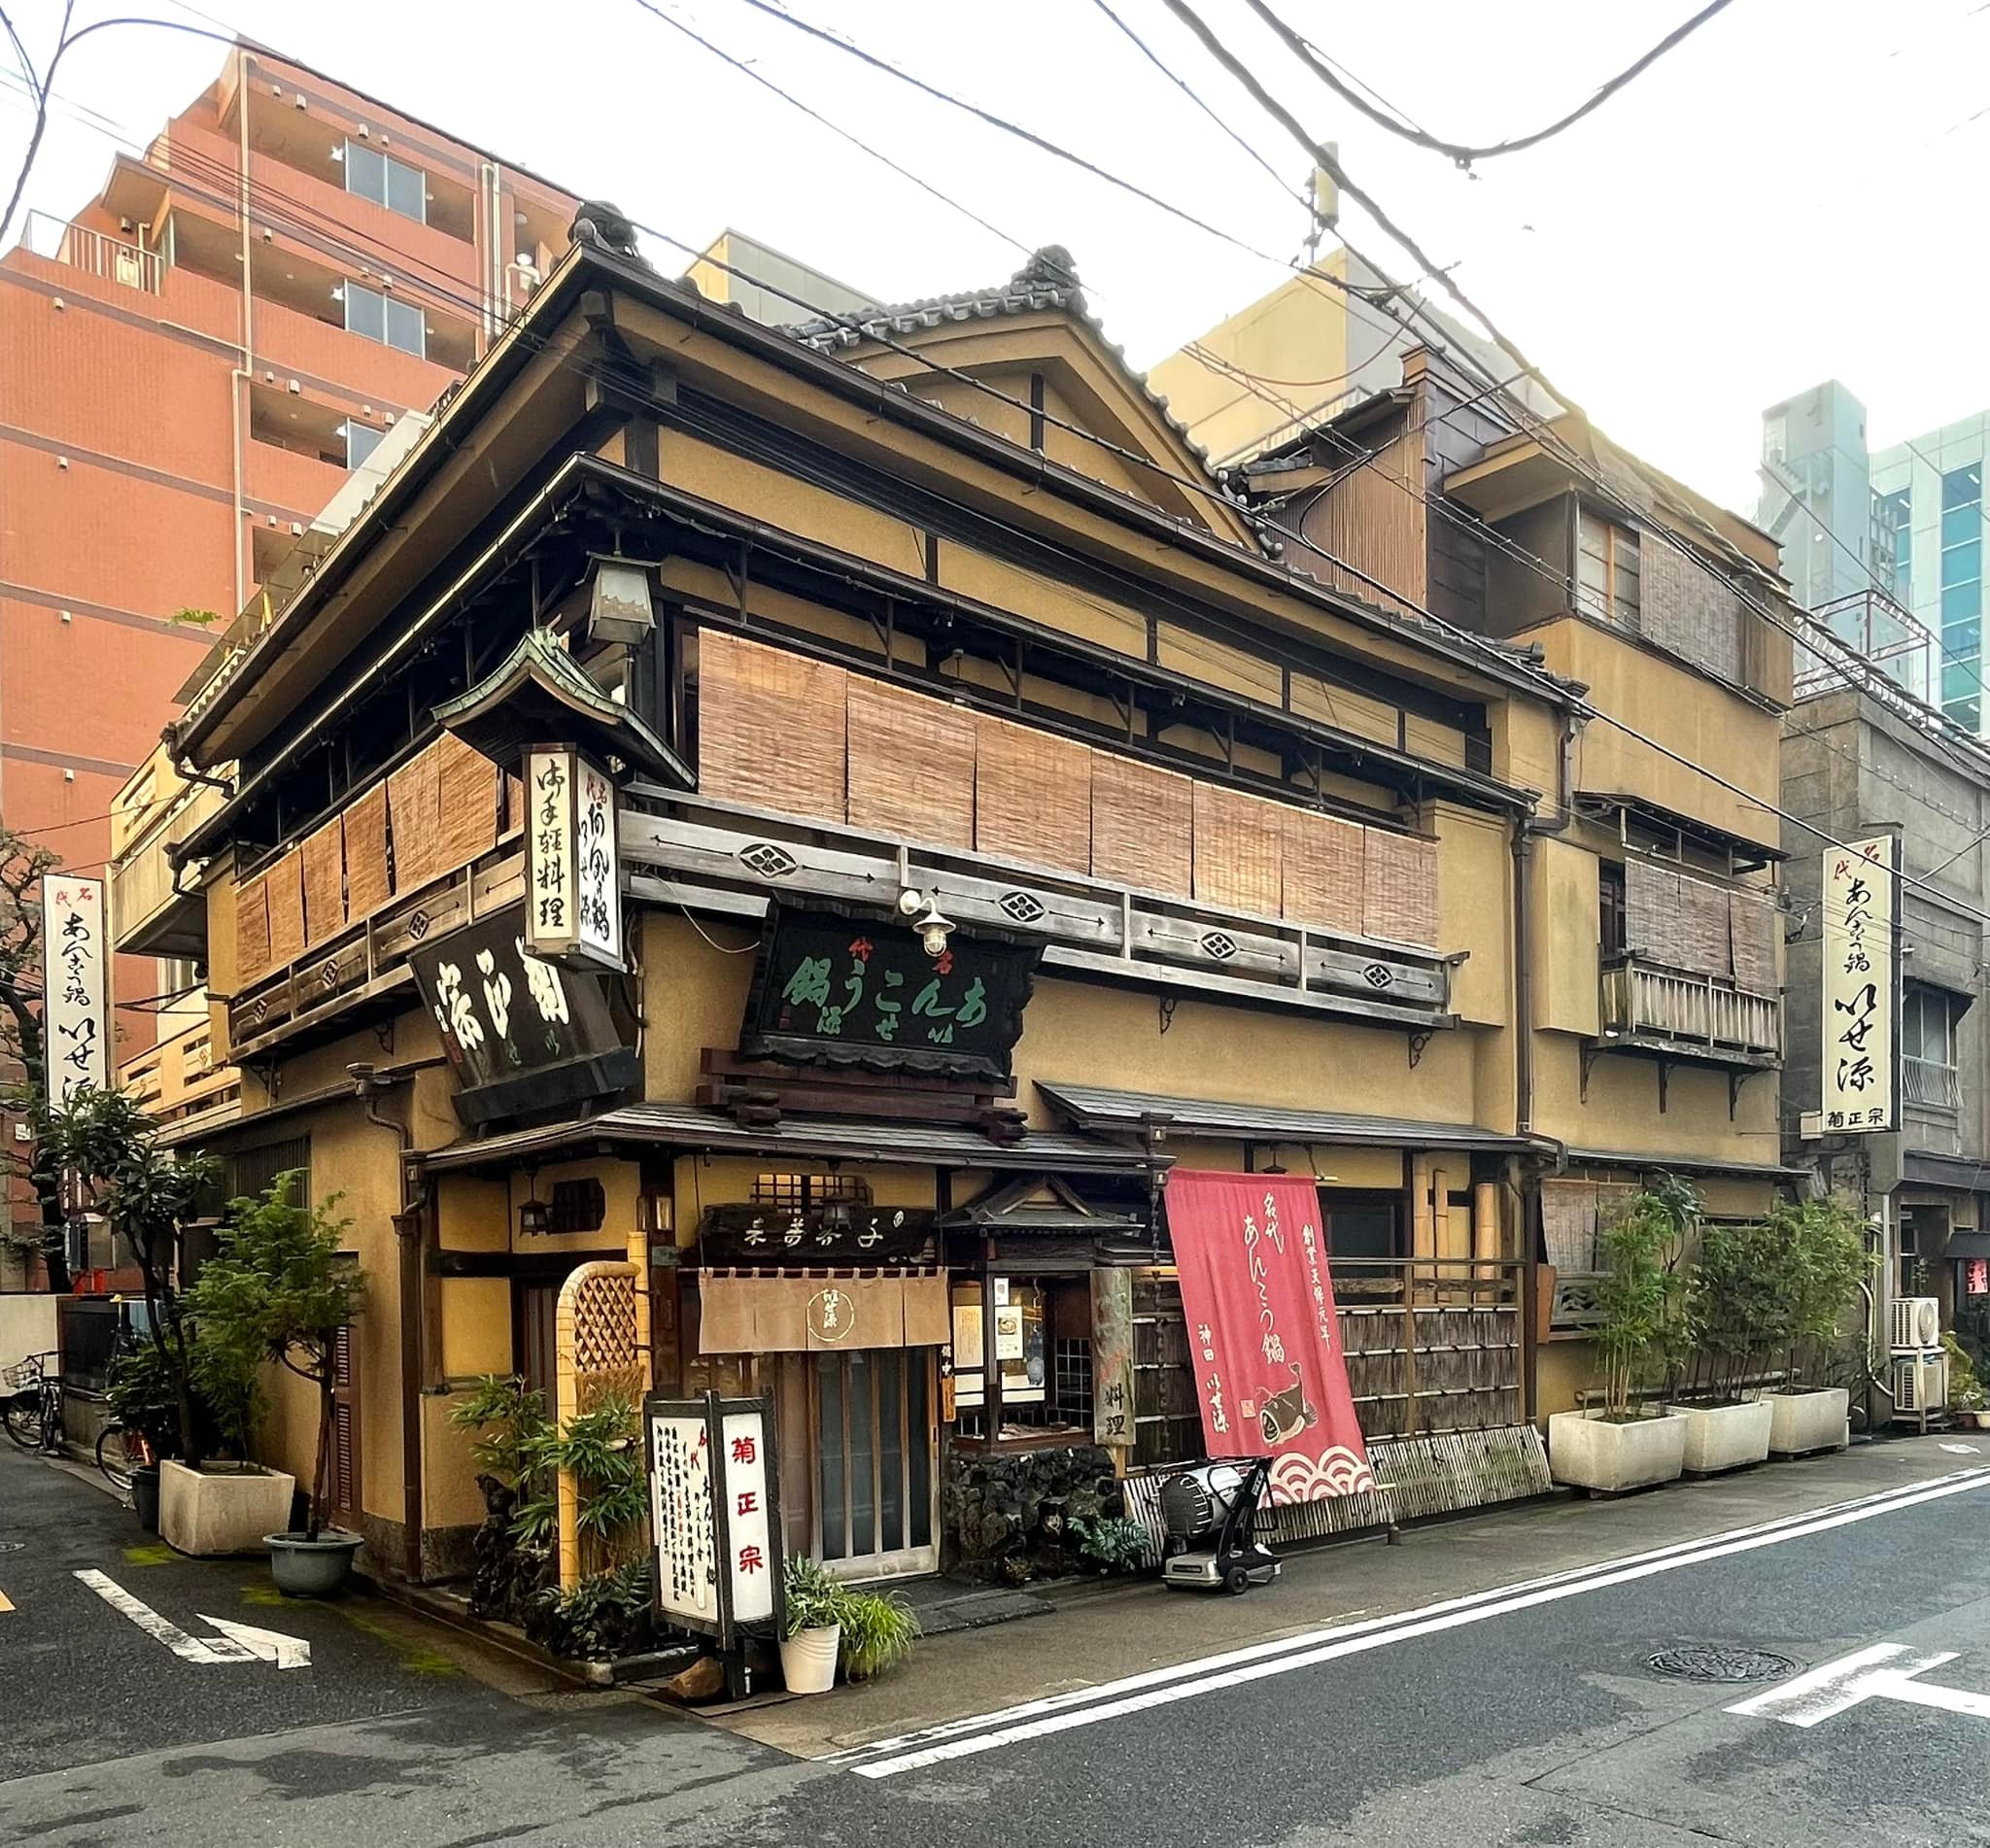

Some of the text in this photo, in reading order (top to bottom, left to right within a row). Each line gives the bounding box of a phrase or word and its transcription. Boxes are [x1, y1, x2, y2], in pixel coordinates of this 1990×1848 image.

[781, 956, 987, 1028] あんこう鍋
[1828, 1108, 1884, 1128] 菊正宗
[732, 1436, 764, 1574] 菊正宗
